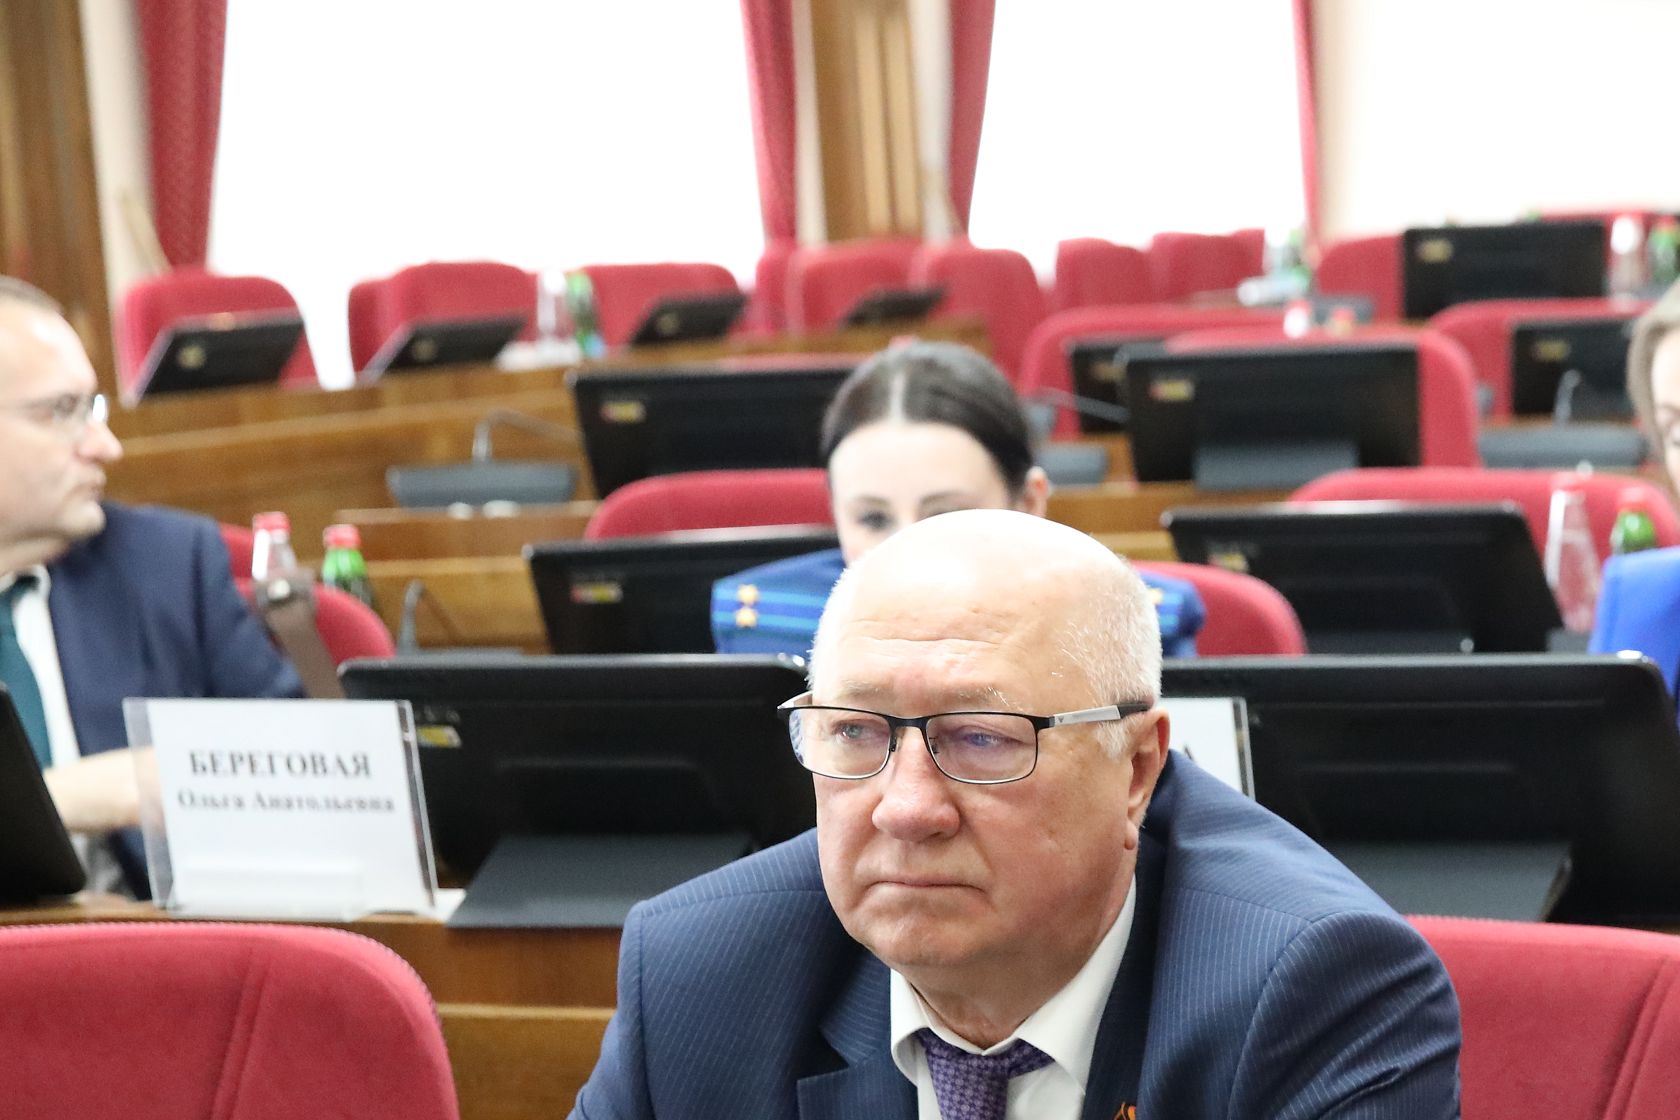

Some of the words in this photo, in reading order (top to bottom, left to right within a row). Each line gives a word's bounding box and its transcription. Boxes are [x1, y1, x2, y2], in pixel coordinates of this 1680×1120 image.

[189, 751, 372, 777] БЕРЕГОВАЯ
[177, 789, 245, 811] Ольга
[254, 790, 395, 813] Анатольевна
